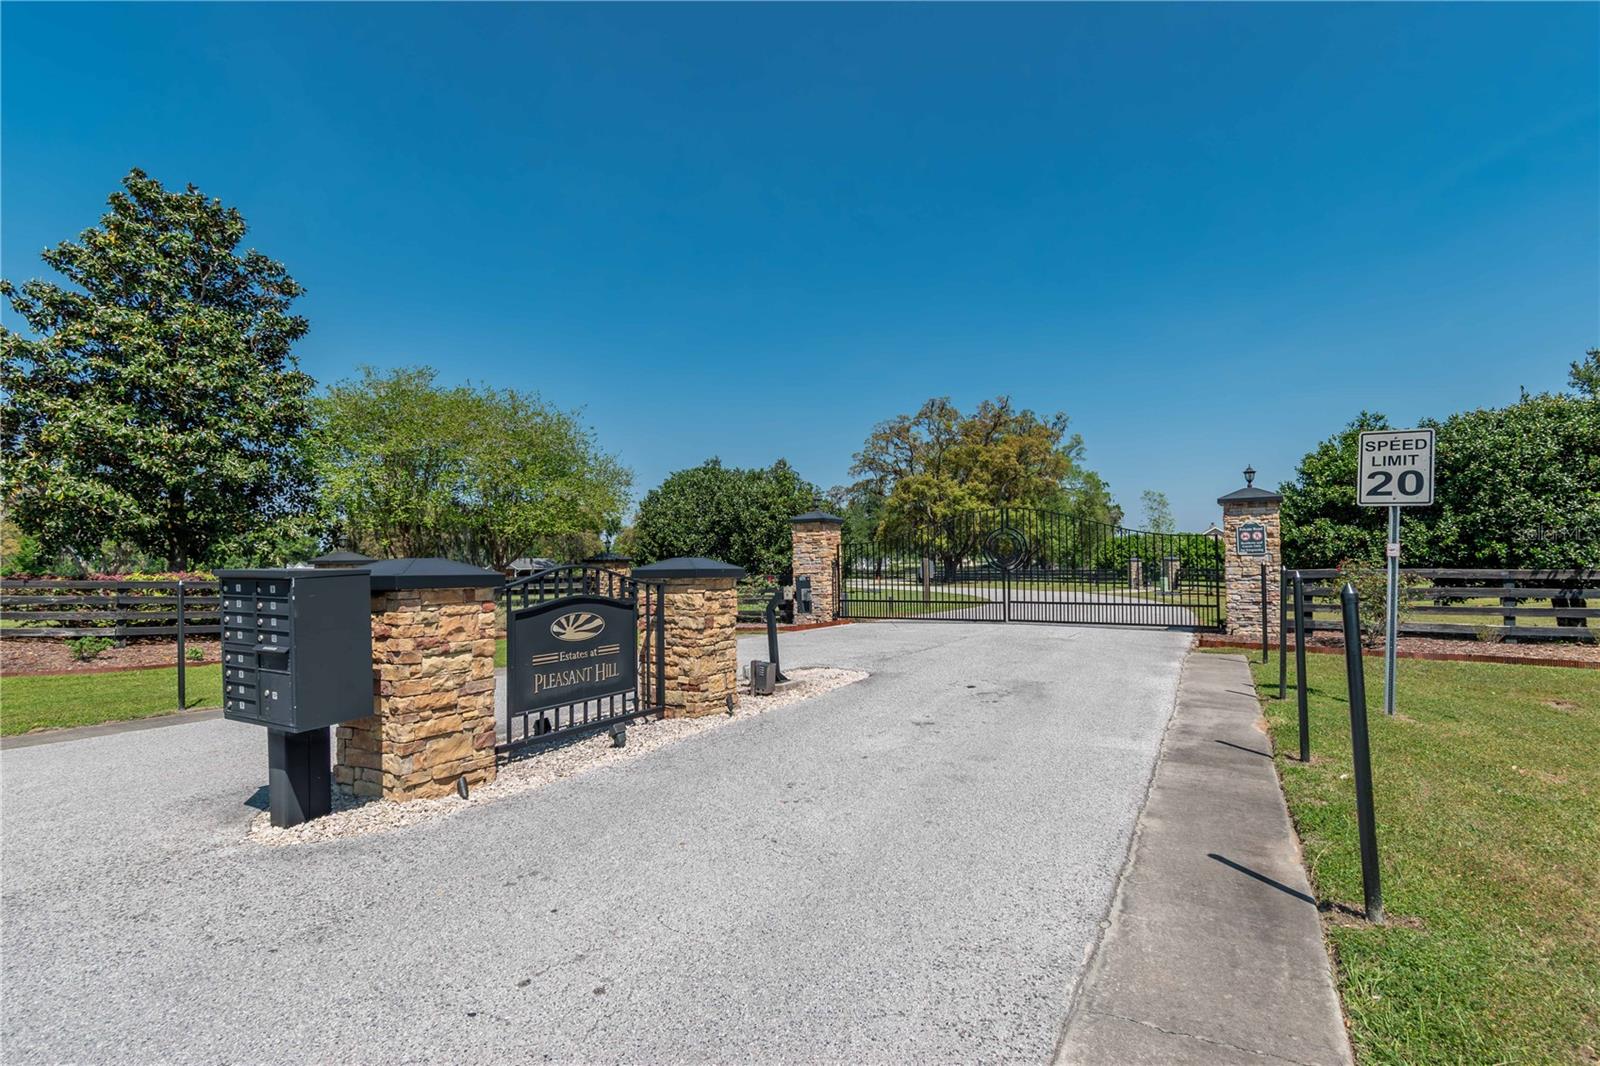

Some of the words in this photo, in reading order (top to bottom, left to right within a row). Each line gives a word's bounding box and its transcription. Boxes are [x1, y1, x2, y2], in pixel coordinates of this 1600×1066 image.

[1365, 439, 1427, 452] SPEED
[1372, 454, 1419, 466] LIMIT
[1366, 470, 1424, 496] 20
[560, 651, 588, 662] Estates
[590, 648, 598, 657] at
[533, 667, 593, 694] PLEASANT
[595, 662, 619, 682] HILL
